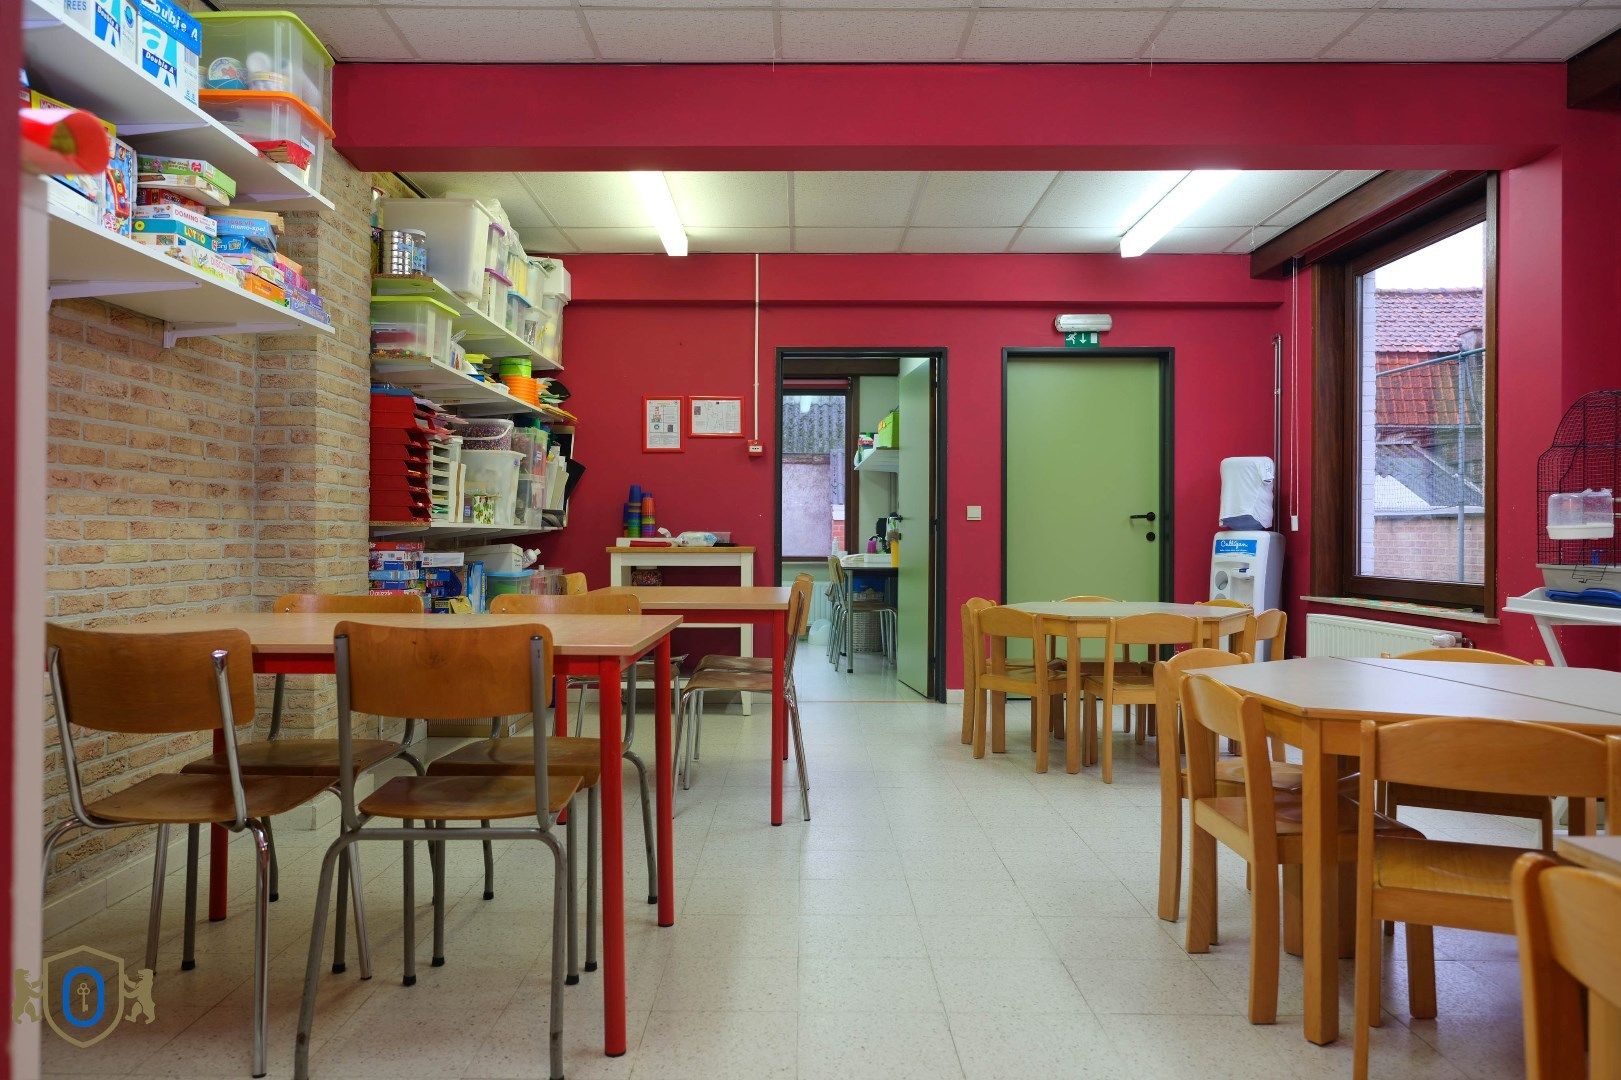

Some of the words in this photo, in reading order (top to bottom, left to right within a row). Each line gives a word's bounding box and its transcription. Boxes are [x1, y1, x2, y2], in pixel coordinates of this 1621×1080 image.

[145, 51, 168, 70] Double
[168, 66, 174, 74] A
[174, 208, 198, 223] DOMINO
[184, 225, 205, 244] LOTTO
